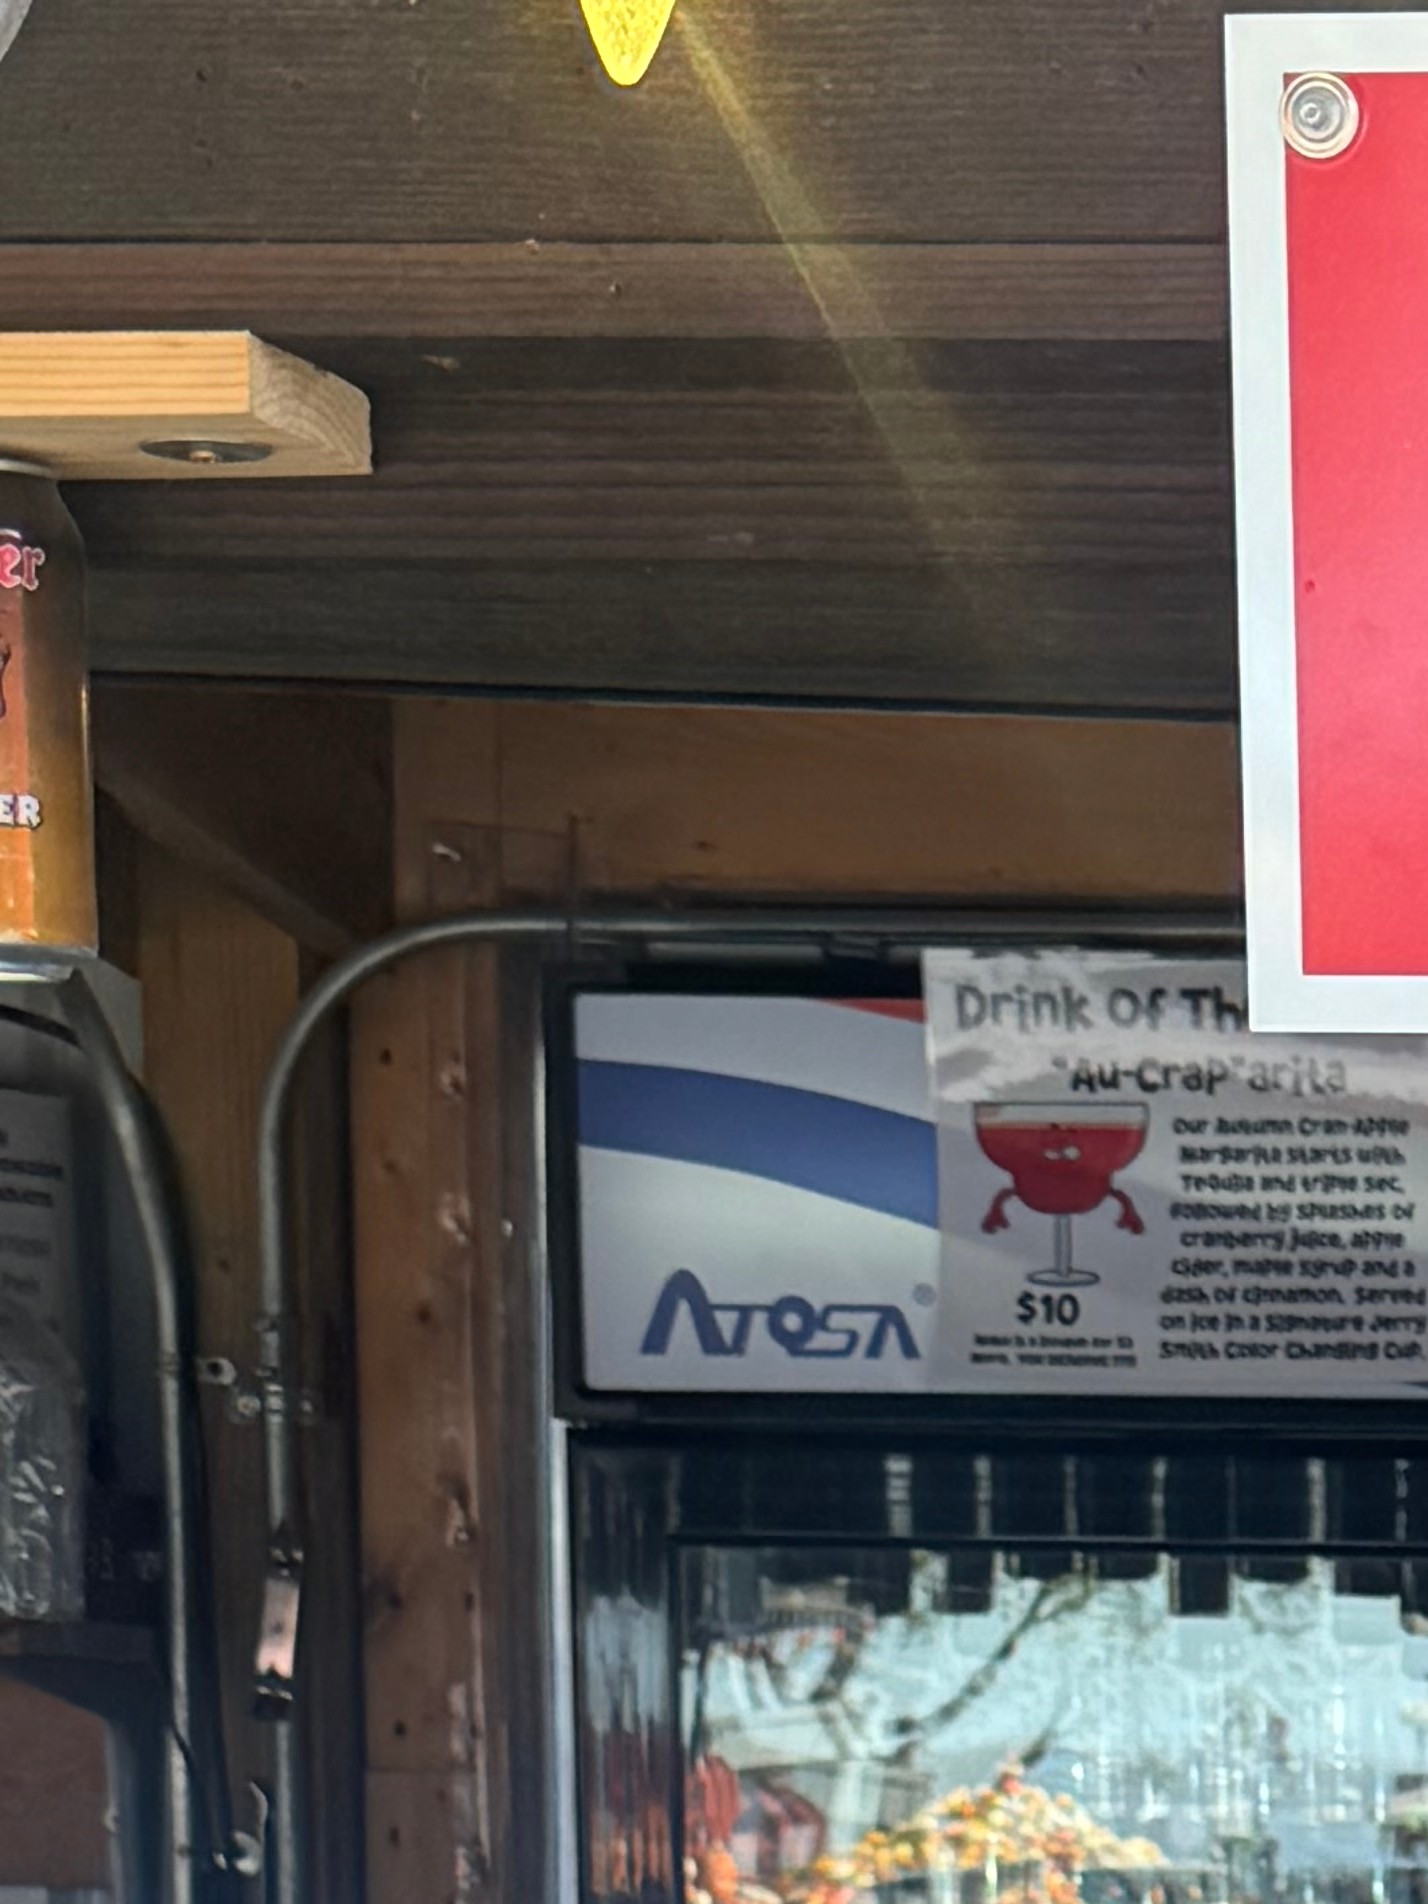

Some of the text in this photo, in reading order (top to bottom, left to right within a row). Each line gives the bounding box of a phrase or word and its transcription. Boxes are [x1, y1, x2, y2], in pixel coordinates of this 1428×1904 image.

[956, 985, 1248, 1032] Drink Of Th
[1016, 1290, 1080, 1326] $10
